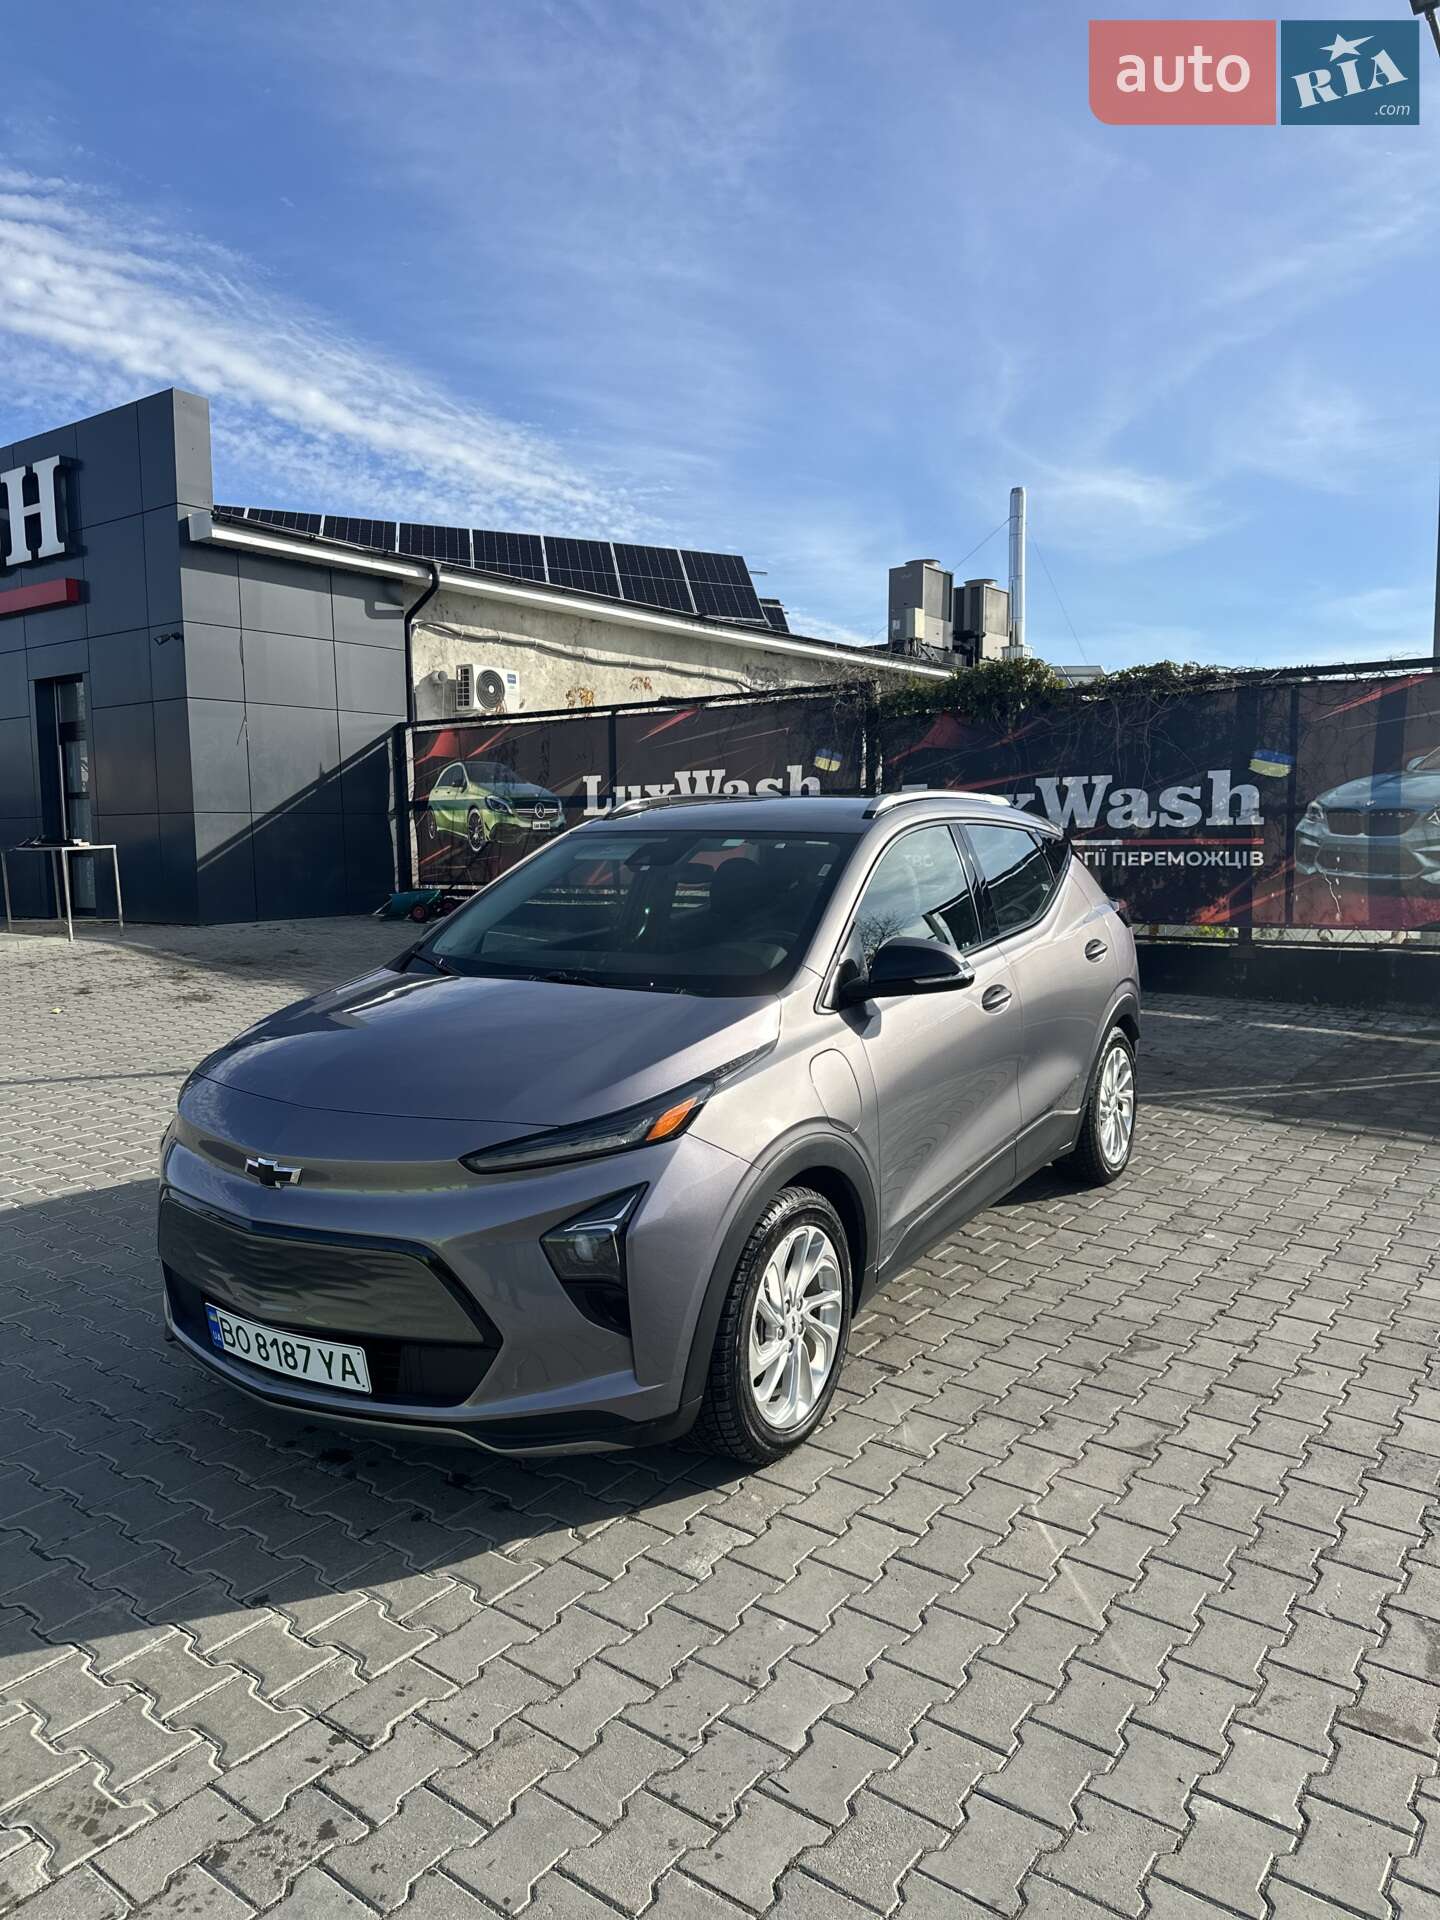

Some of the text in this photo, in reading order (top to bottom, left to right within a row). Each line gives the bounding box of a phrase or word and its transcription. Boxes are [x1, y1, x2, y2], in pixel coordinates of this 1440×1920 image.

[902, 769, 1265, 829] Wash
[1113, 851, 1265, 870] ПЕРЕМОЖЦІВ
[219, 1316, 361, 1386] BO 8187 YA
